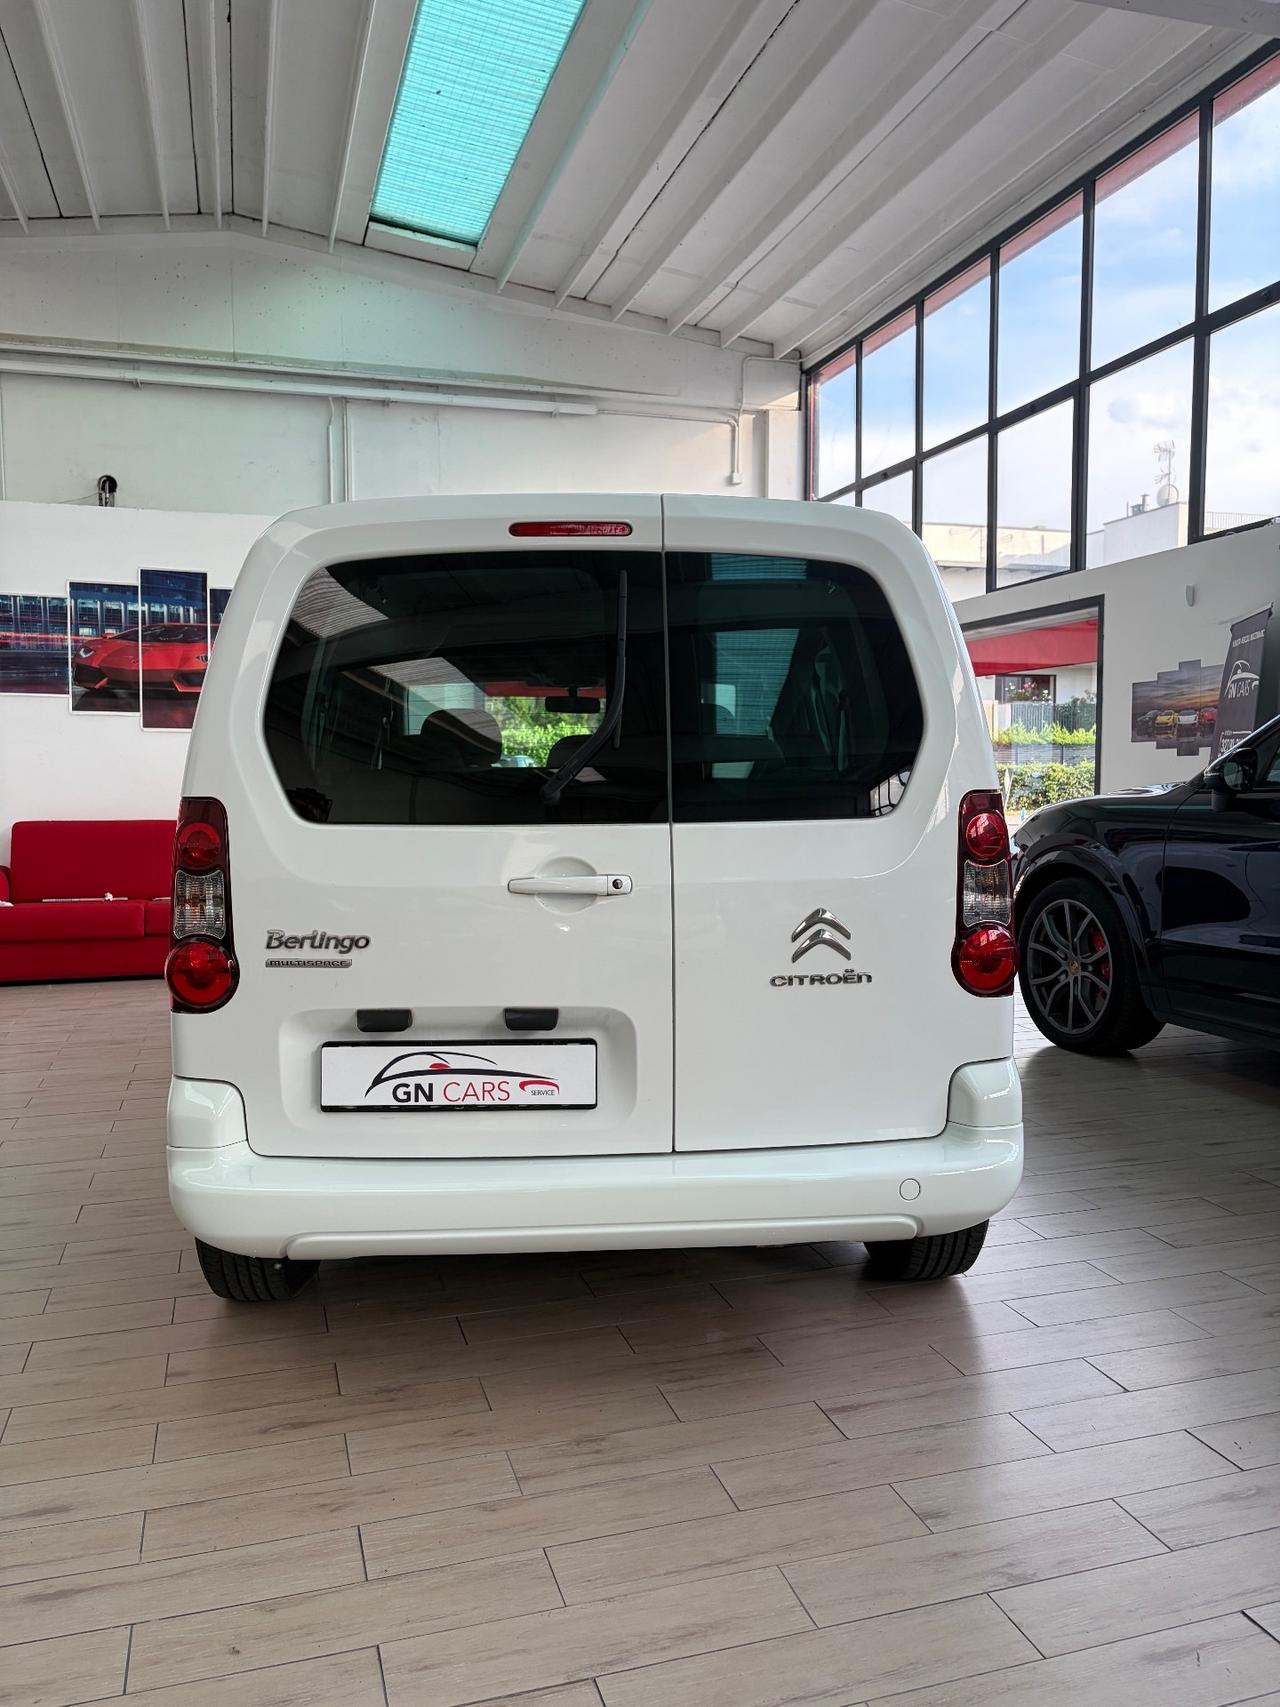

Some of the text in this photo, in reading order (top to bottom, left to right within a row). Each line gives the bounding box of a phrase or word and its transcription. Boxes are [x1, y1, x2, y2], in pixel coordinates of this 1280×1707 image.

[265, 929, 371, 954] Berlingo
[267, 959, 349, 968] MULTISPACE
[769, 968, 873, 987] CITROËN
[392, 1080, 511, 1103] GN CARS
